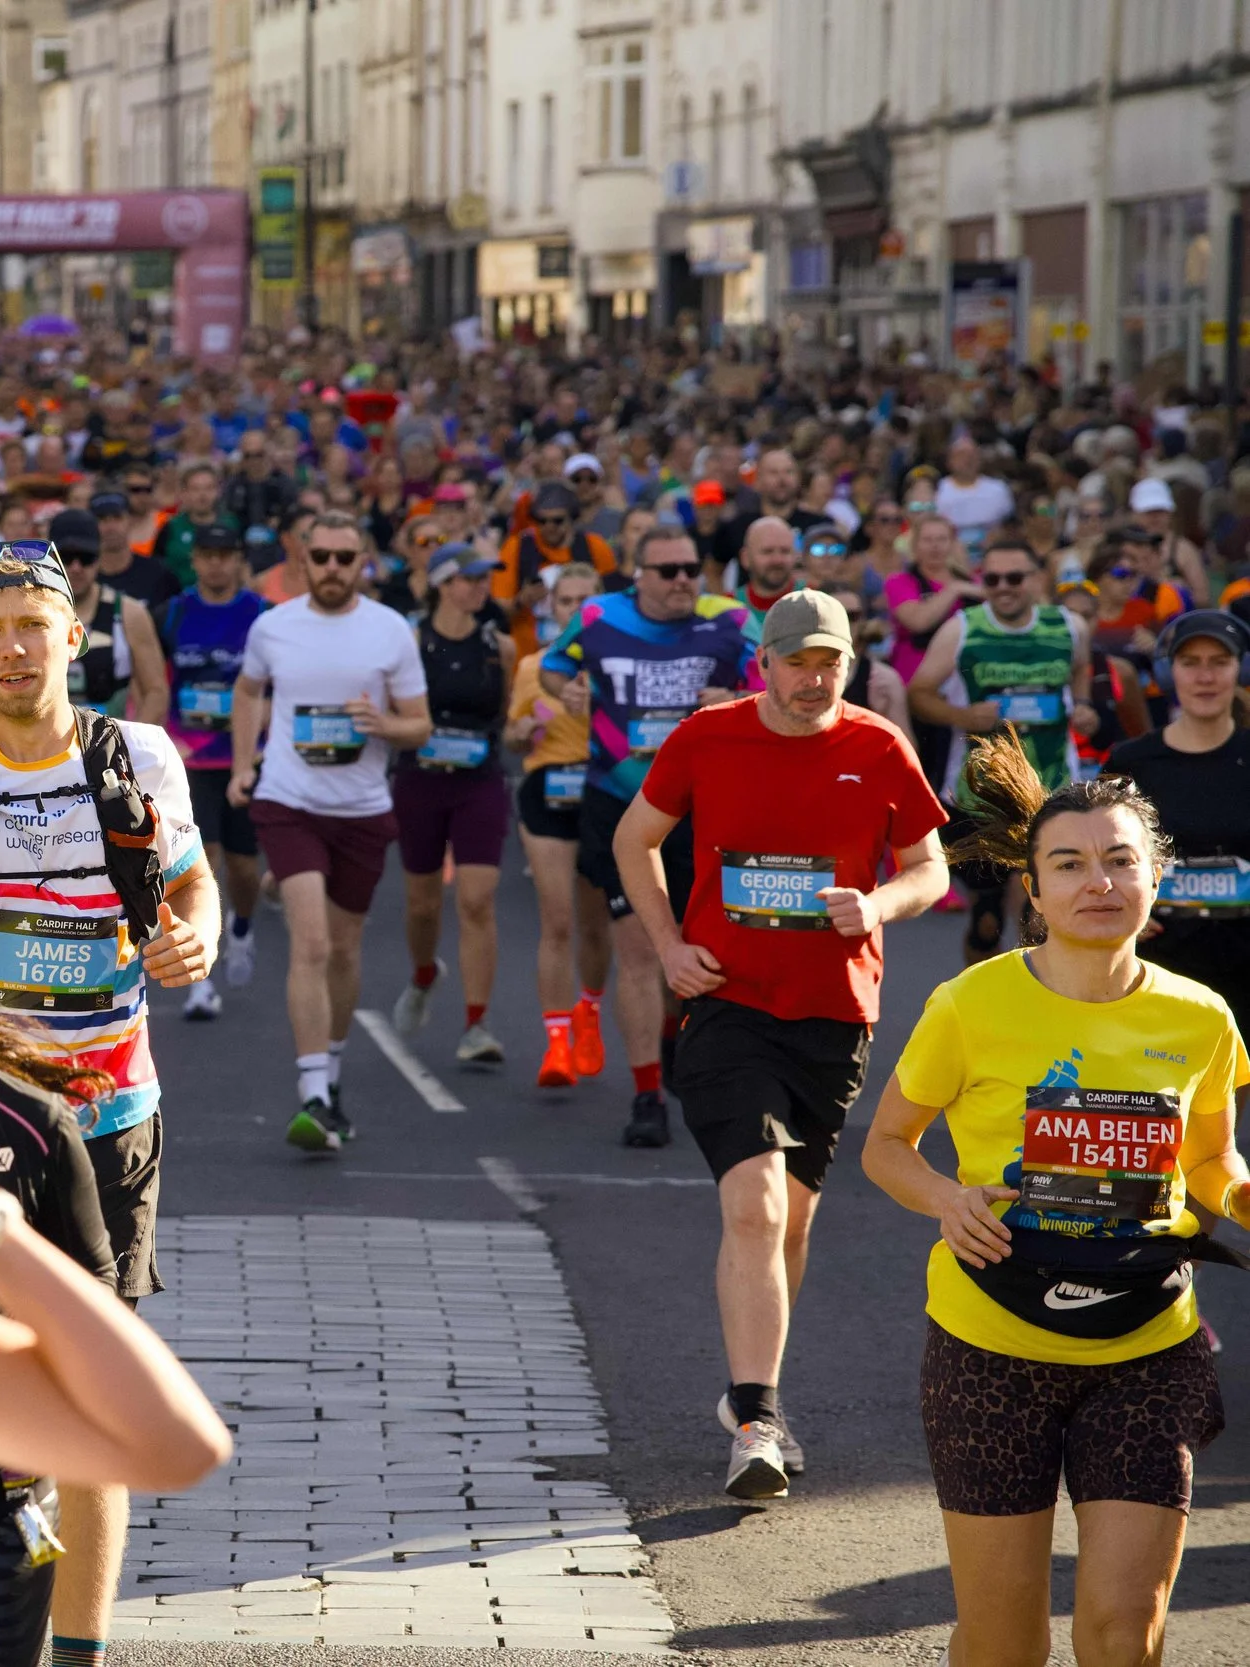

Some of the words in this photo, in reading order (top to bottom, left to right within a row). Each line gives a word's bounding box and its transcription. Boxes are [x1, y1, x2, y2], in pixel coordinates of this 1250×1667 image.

[4, 818, 50, 846] caer
[760, 855, 792, 864] CARDIFF
[793, 857, 814, 865] HALF
[740, 873, 814, 891] GEORGE
[1171, 873, 1237, 896] 30891
[749, 890, 802, 908] 17201
[36, 919, 74, 929] CARDIFF
[76, 922, 98, 930] HALF
[15, 940, 92, 962] JAMES
[19, 962, 86, 984] 16769
[1086, 1092, 1130, 1104] CARDIFF
[1131, 1095, 1156, 1106] HALF
[1034, 1116, 1092, 1140] ANA
[1100, 1119, 1175, 1145] BELEN
[1069, 1142, 1148, 1169] 15415
[1125, 1172, 1146, 1180] FEMALE
[1029, 1193, 1056, 1202] BAGGAGE
[1056, 1195, 1074, 1203] LABEL
